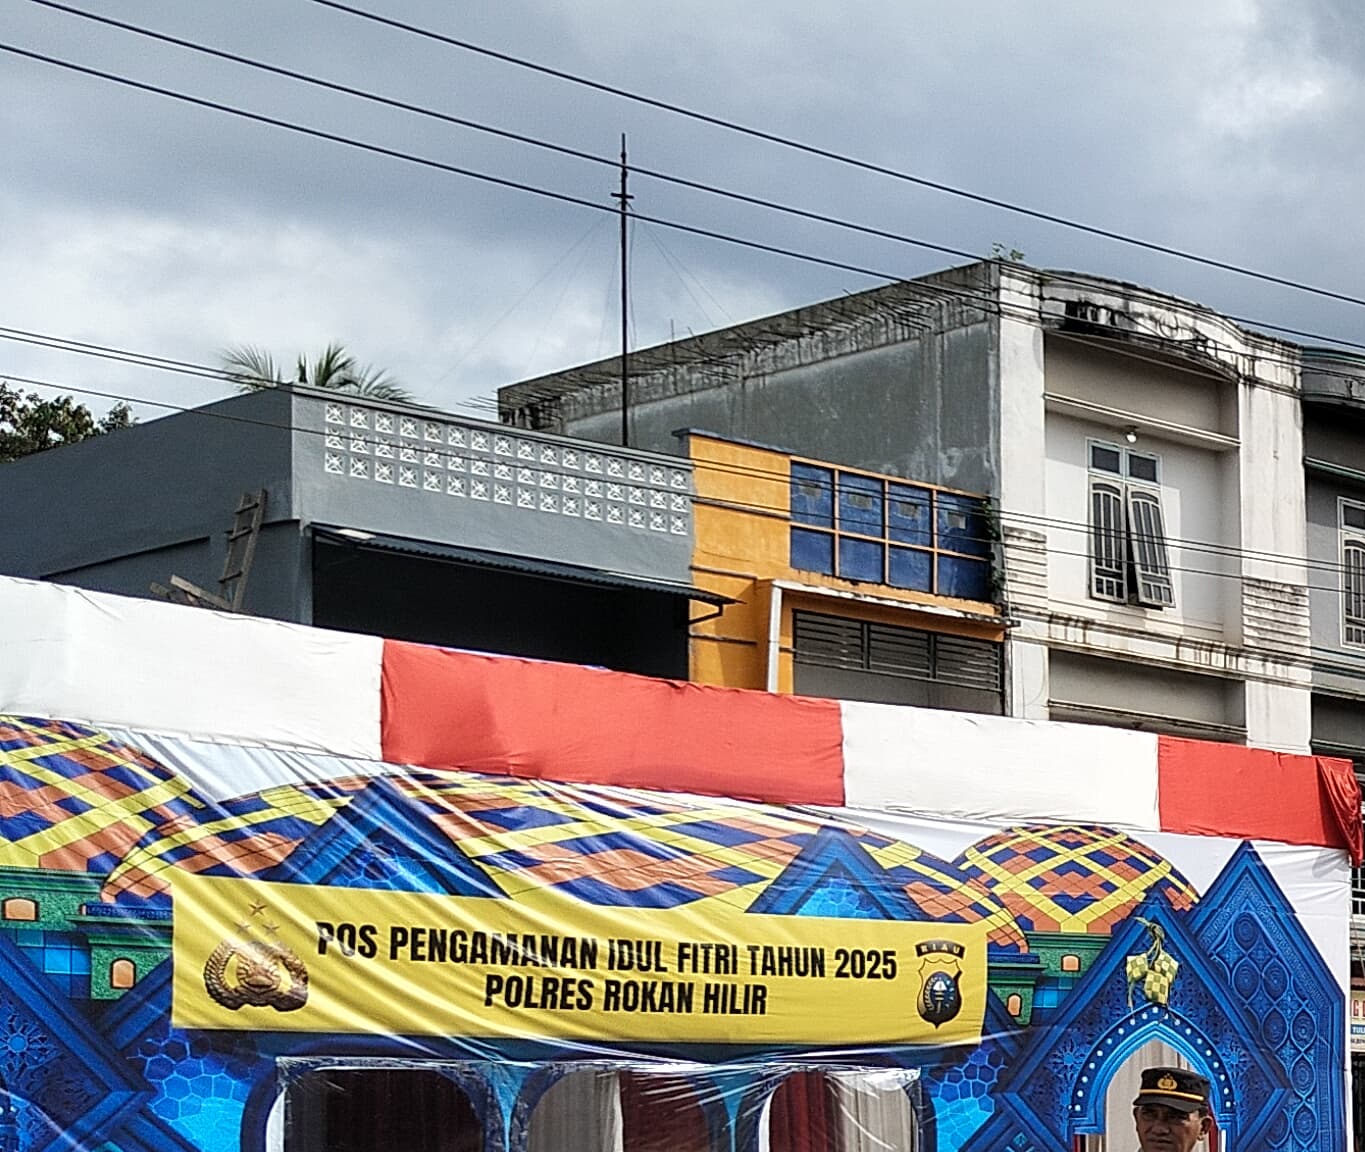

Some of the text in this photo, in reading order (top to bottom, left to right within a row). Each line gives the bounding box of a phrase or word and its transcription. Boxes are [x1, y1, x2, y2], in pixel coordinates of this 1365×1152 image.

[315, 921, 898, 980] POS PENGAMANAN IDUL FITRI TAHUN 2025
[920, 943, 961, 954] RIAU
[484, 974, 768, 1015] POLRES ROKAN HILIR
